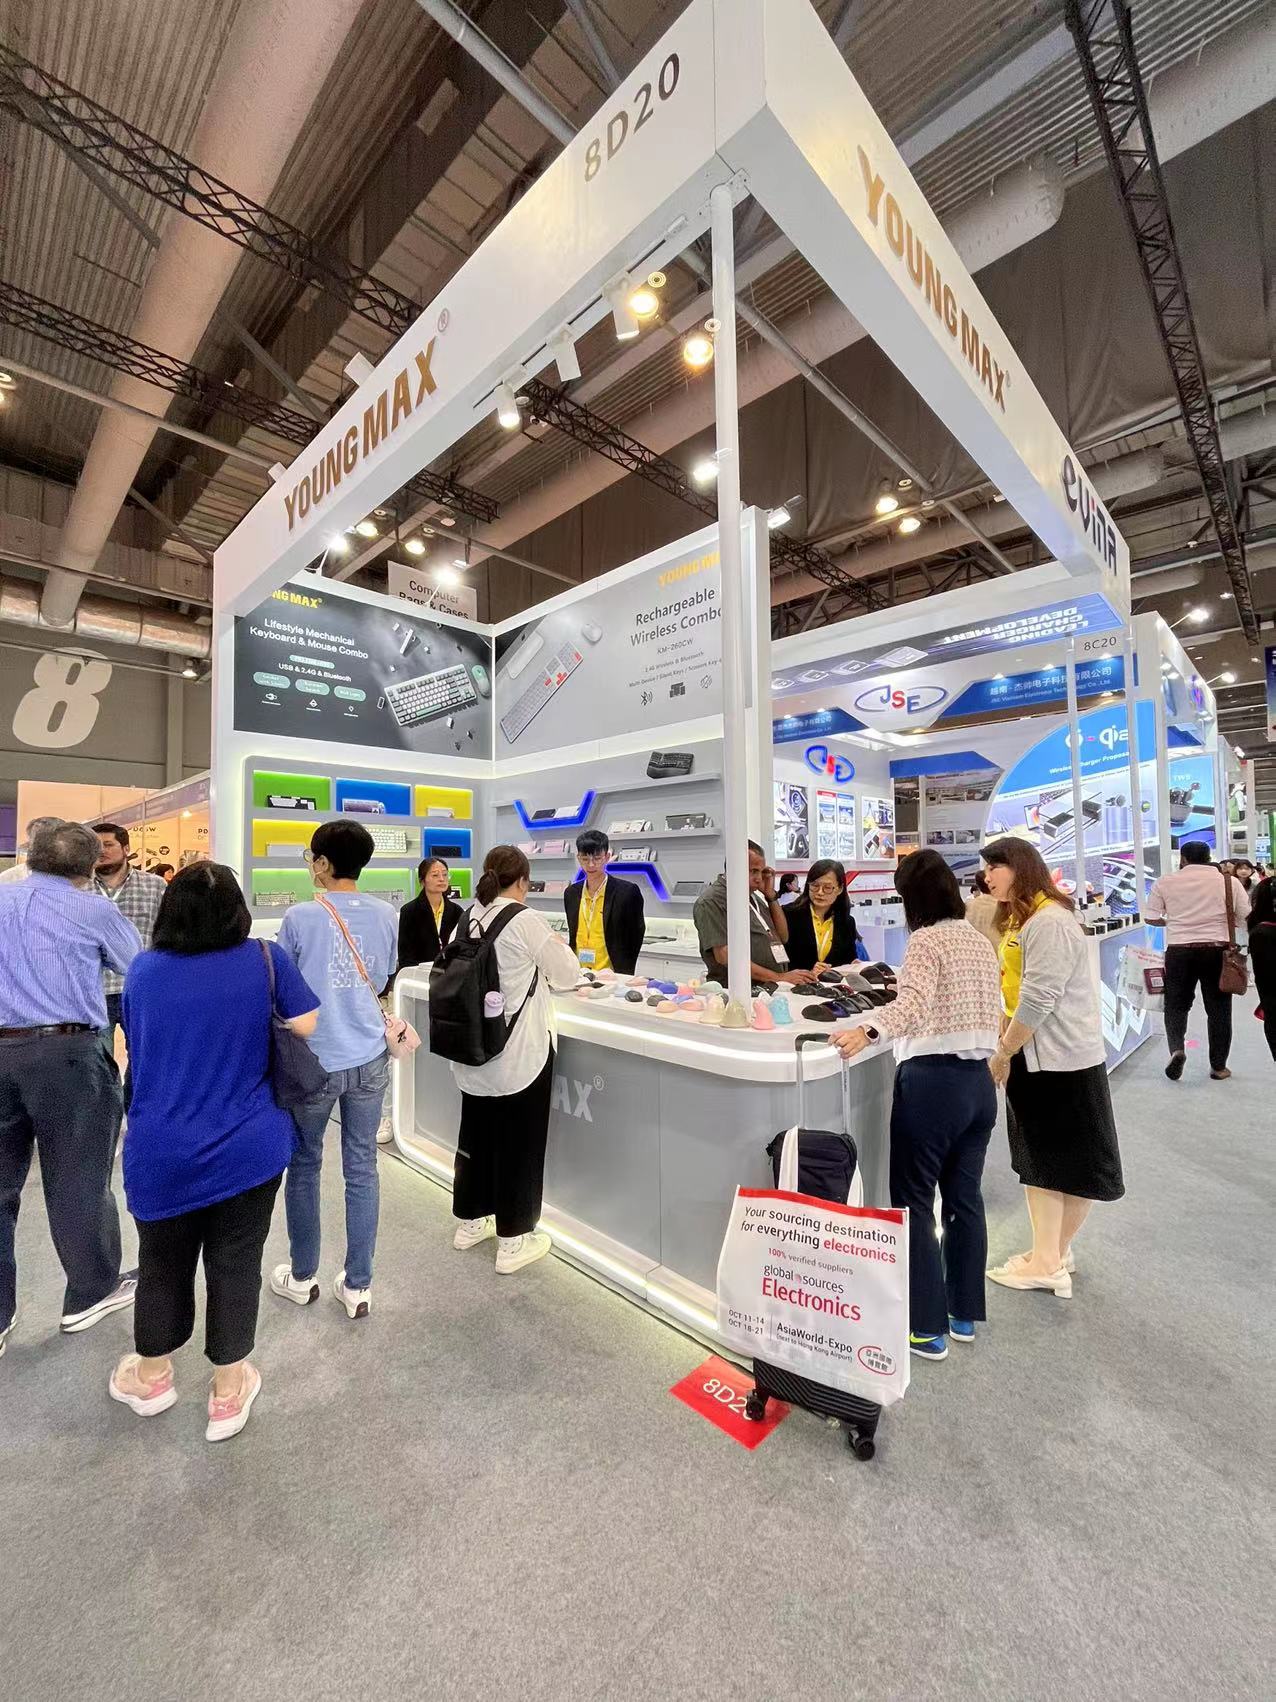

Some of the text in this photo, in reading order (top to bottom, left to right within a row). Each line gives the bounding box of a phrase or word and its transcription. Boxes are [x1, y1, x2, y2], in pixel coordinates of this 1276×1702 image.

[584, 52, 680, 182] 8D20
[409, 580, 459, 604] Computer
[636, 588, 715, 626] Rechargeable
[264, 618, 355, 646] Lifestyle Mechanical
[630, 620, 677, 647] Wireless
[943, 607, 1078, 644] DEVELOPMENT
[991, 614, 1084, 641] CHARGER
[1007, 620, 1089, 643] LEADING
[249, 626, 369, 659] Keyboard & Mouse Combo
[1084, 636, 1117, 651] 8C20
[278, 662, 294, 672] USB
[294, 665, 301, 673] &
[301, 666, 317, 676] 2.4G
[323, 671, 352, 682] Bluetooth
[12, 646, 113, 749] 8
[1102, 751, 1130, 762] Proposa
[551, 1074, 593, 1122] AX
[745, 1206, 897, 1246] Your sourcing destination
[740, 1221, 897, 1264] for everything electronics
[768, 1248, 854, 1276] 100% verified suppliers
[763, 1264, 844, 1294] global sources
[762, 1277, 862, 1322] Electronics
[728, 1309, 765, 1324] OCT 11-14
[728, 1318, 741, 1328] OCT
[777, 1322, 853, 1353] AsiaWorld-Expo
[798, 1341, 813, 1351] Hong
[814, 1346, 829, 1356] Kong
[830, 1350, 853, 1363] Airport)
